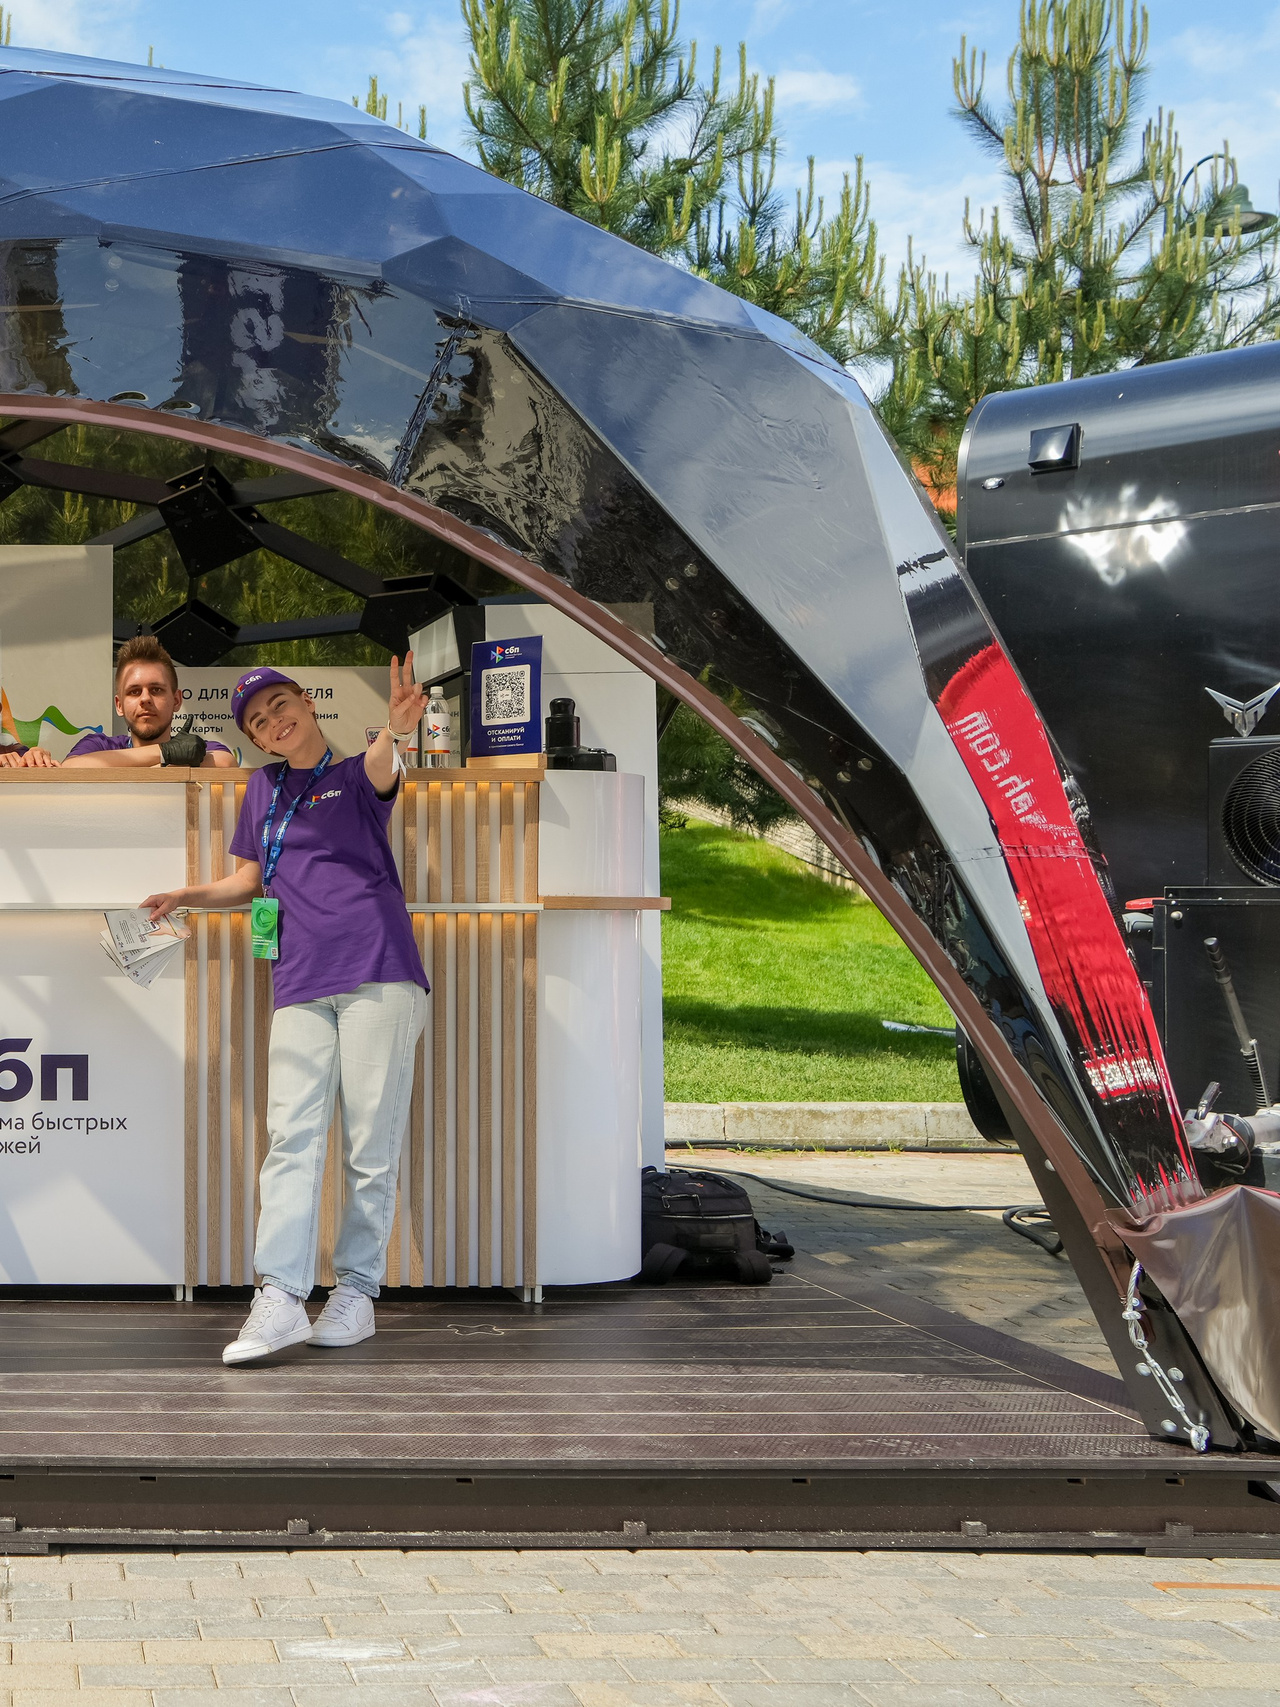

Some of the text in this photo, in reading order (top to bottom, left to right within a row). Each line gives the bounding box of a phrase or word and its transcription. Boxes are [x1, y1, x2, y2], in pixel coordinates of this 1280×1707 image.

[505, 646, 520, 654] сбп
[245, 675, 262, 685] сбп
[198, 688, 228, 701] ДЛЯ
[192, 726, 223, 734] карты
[487, 727, 525, 736] ОТСКАНИРУЙ
[321, 790, 341, 799] сбп
[31, 1112, 128, 1135] быстрых
